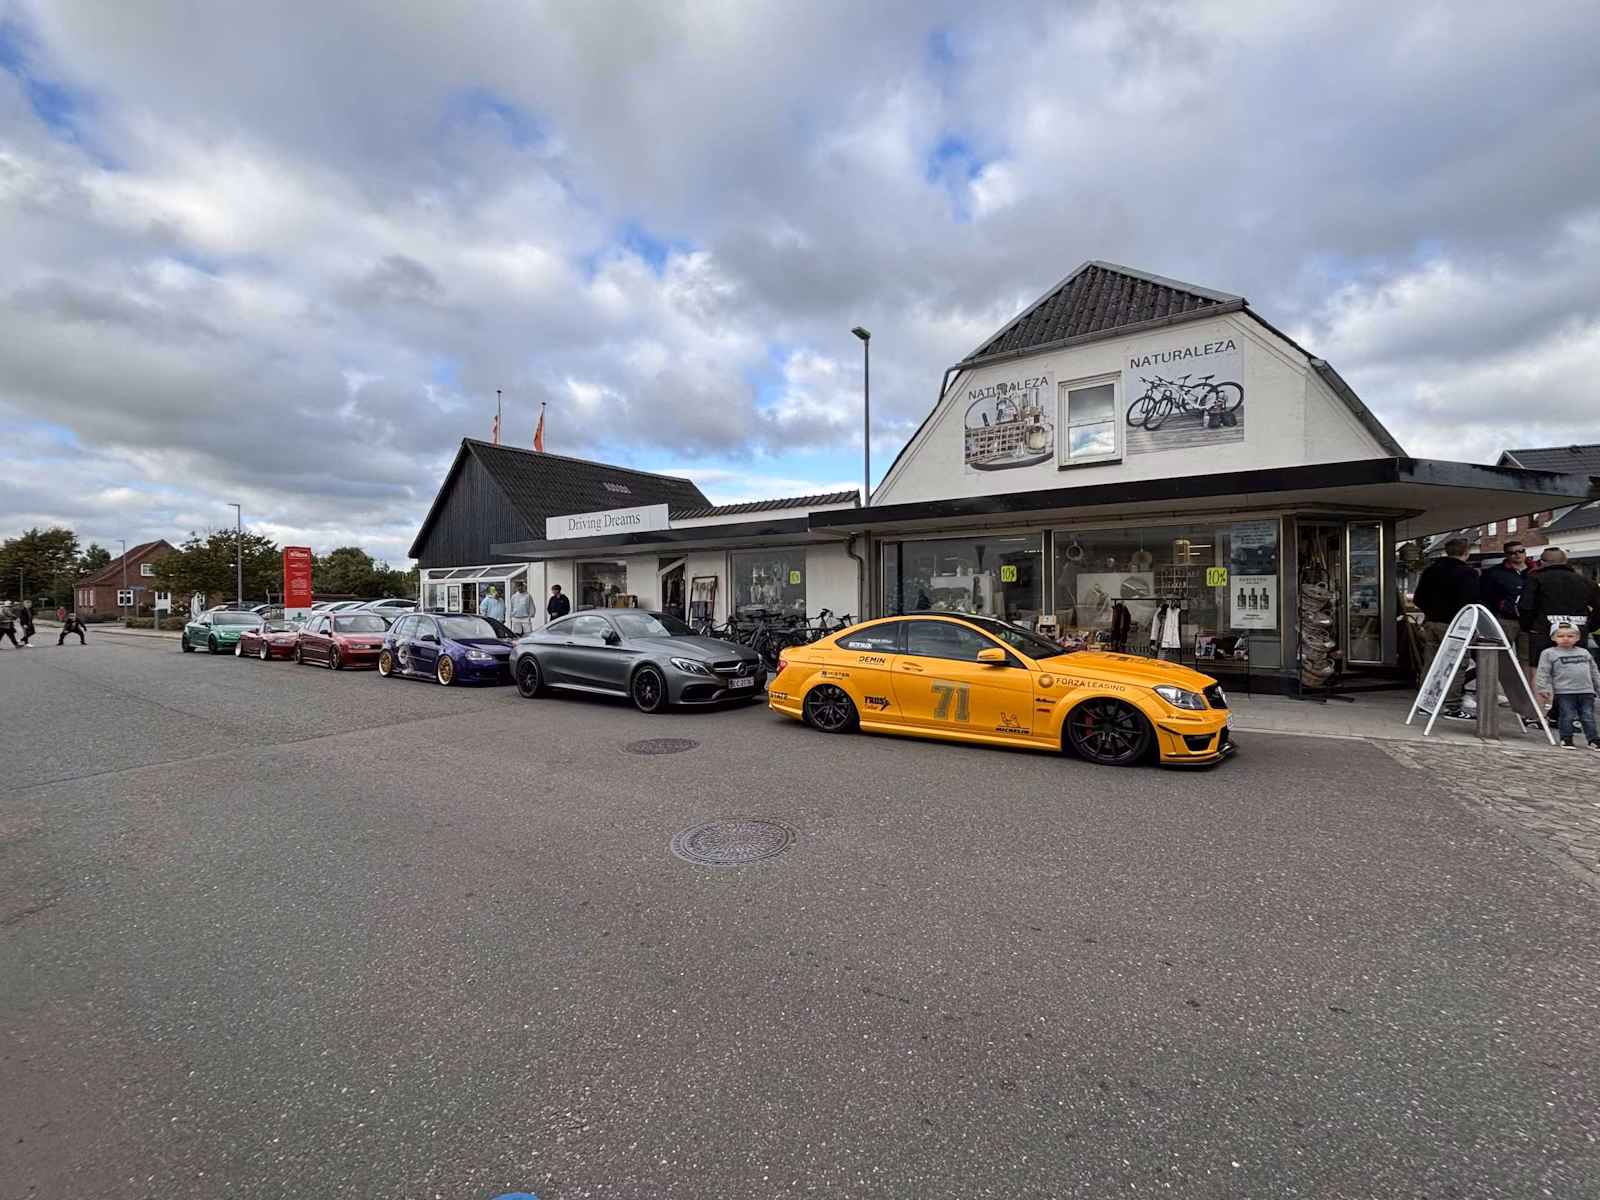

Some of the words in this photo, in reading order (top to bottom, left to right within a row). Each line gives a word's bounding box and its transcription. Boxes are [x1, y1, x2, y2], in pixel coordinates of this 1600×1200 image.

[1130, 340, 1236, 369] NATURALEZA
[568, 516, 602, 531] Driving
[604, 514, 641, 528] Dreams
[1002, 567, 1015, 580] 10%
[1207, 569, 1226, 585] 10%
[1056, 677, 1085, 687] FORZA
[1087, 681, 1126, 692] LEASING
[930, 679, 971, 722] 71
